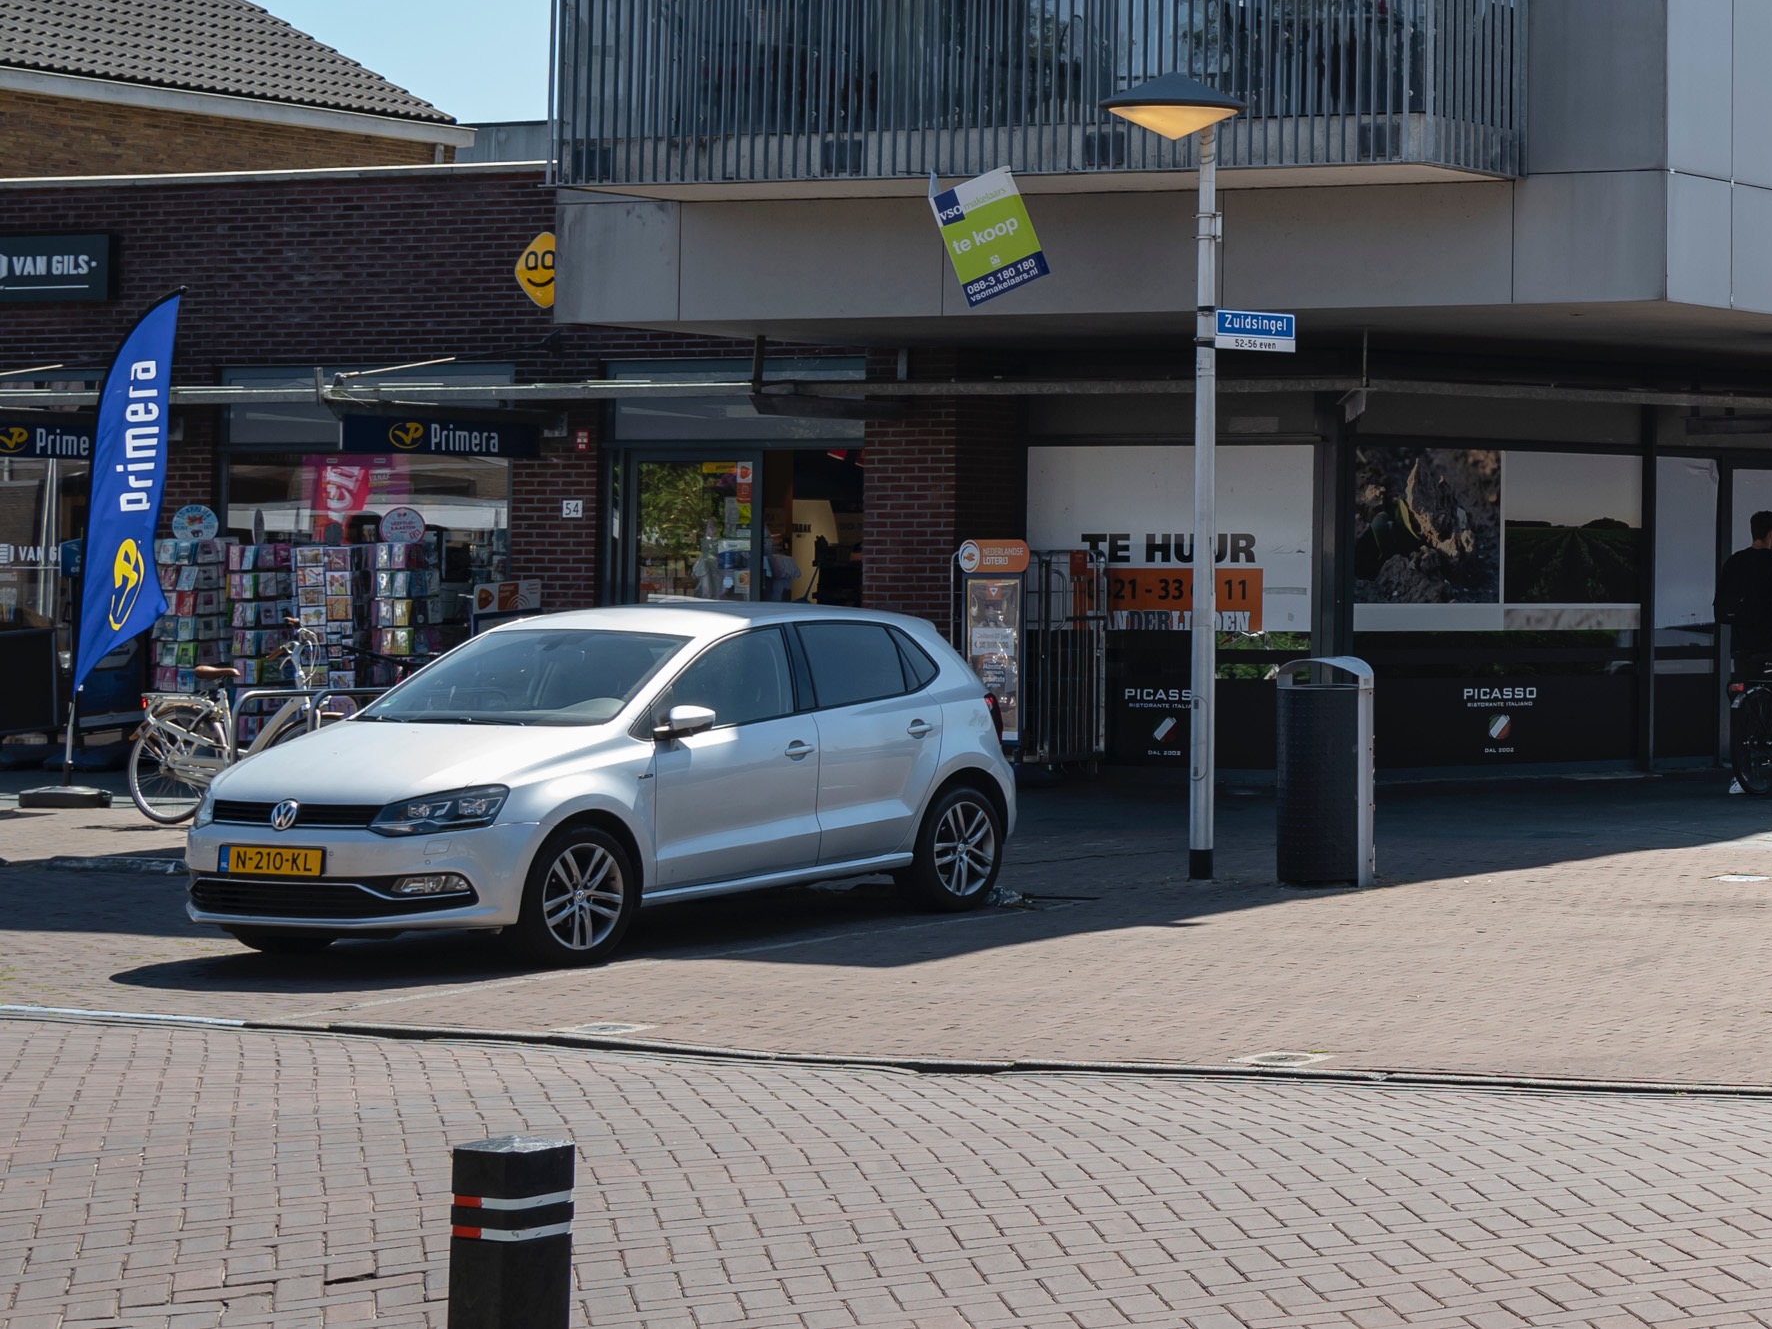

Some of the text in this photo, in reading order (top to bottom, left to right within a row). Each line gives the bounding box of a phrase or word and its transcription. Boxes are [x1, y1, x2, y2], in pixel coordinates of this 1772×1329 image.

[940, 187, 1006, 221] vso makelaars
[952, 217, 1019, 255] te koop
[12, 255, 48, 276] VAN
[967, 258, 1036, 295] 088-3 180 180
[970, 268, 1039, 302] vsomakelaars.nl
[1224, 314, 1287, 334] Zuidsingel
[1234, 338, 1277, 350] 52-56 even
[36, 428, 90, 457] Prime
[116, 360, 160, 512] primera
[431, 423, 499, 453] Primera
[564, 502, 580, 516] 54
[18, 546, 44, 562] VAN
[982, 547, 1024, 557] NEDERLANDSE
[1081, 533, 1257, 563] TE HUUR
[982, 556, 1009, 565] LOTERIJ
[1158, 578, 1184, 600] 33
[1224, 579, 1247, 600] 11
[1124, 688, 1192, 701] PICASS
[1463, 687, 1537, 700] PICASSO
[235, 850, 313, 872] N-210-KL
